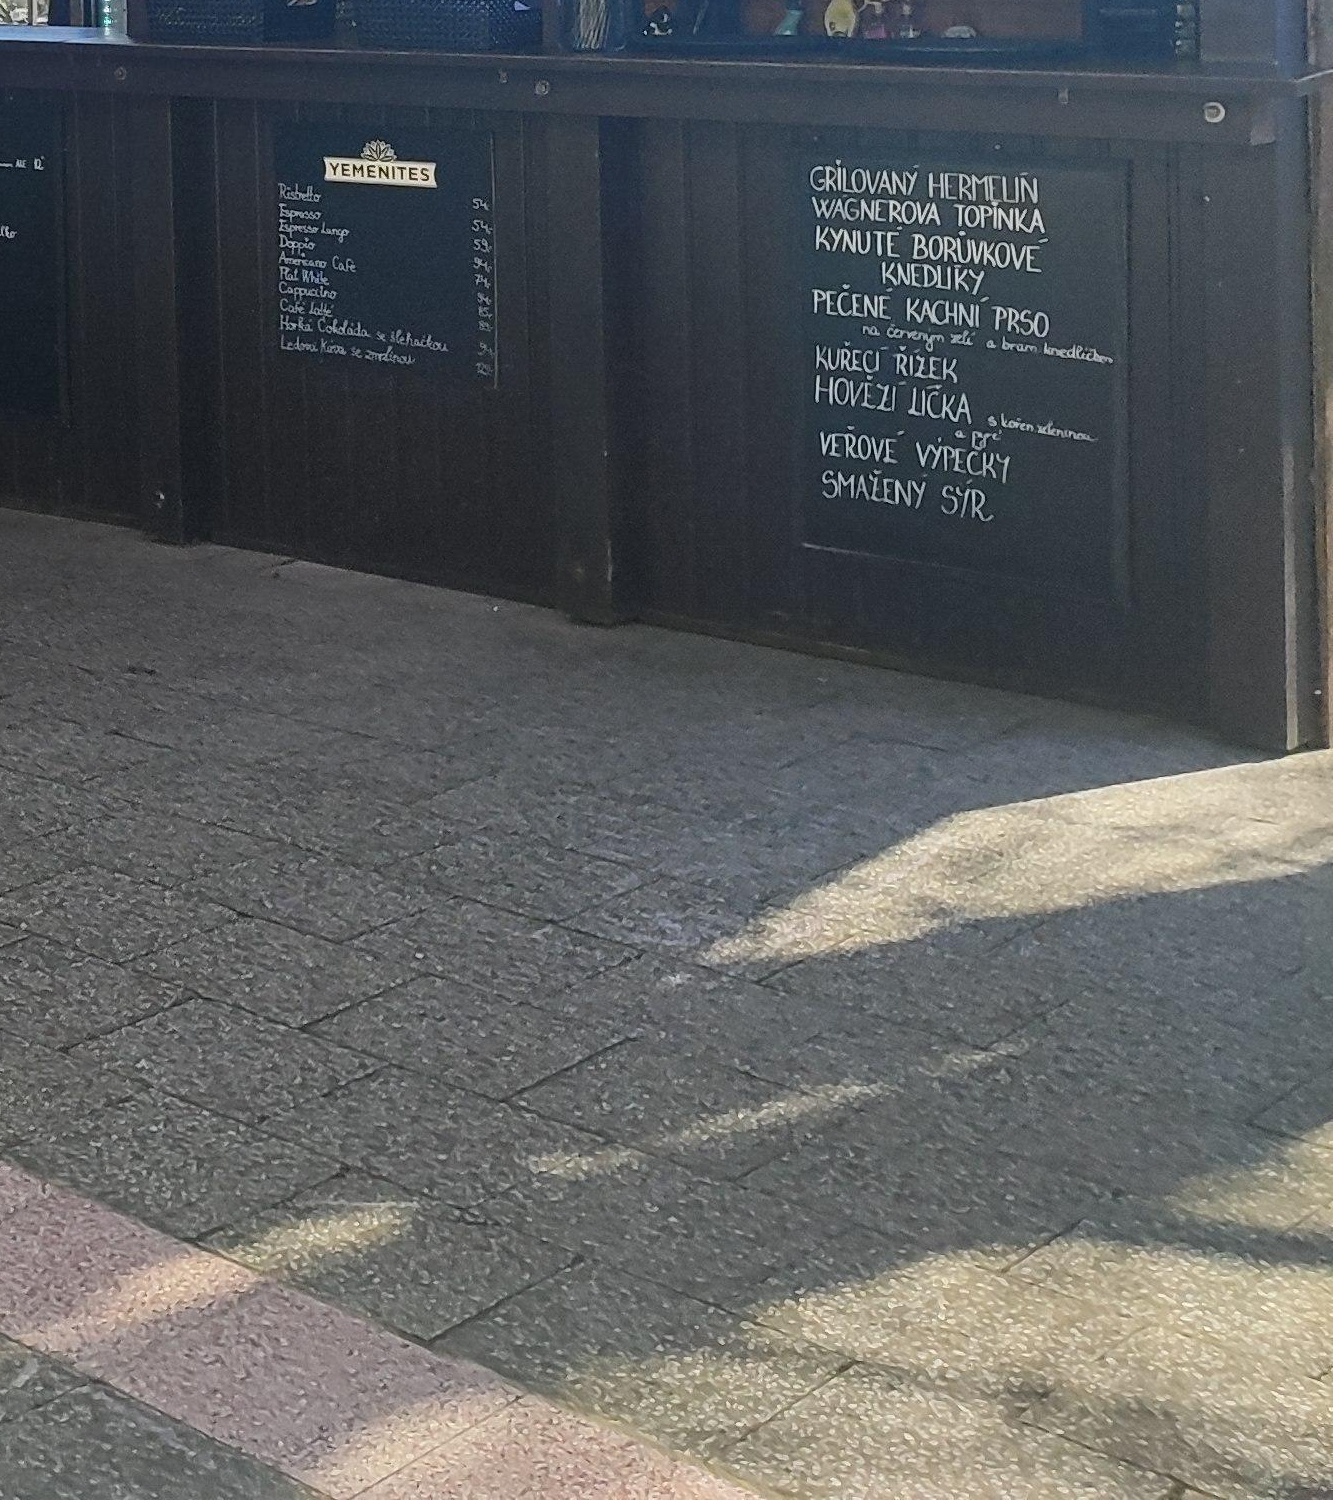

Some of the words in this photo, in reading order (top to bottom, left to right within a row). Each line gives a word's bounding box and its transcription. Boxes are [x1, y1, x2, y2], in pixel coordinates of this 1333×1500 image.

[329, 161, 431, 183] YEMENITES
[809, 159, 919, 197] GRILOVANÝ
[277, 183, 323, 203] Ristretto
[278, 202, 323, 222] Espresso
[953, 200, 1047, 235] TOPINKA
[278, 218, 319, 239] Espresso
[815, 225, 904, 258] KYNUTÉ
[278, 234, 317, 255] Doppio
[812, 283, 894, 321] PEČENÉ
[906, 296, 991, 329] KACHNÍ
[991, 305, 1051, 338] PRSO
[862, 325, 881, 337] na
[985, 340, 997, 349] a
[815, 340, 890, 373] KUŘECÍ
[814, 374, 907, 412] HOVĚZÍ
[953, 429, 968, 440] a
[821, 468, 928, 510] SMAŽENÝ
[941, 478, 994, 522] SÝR
